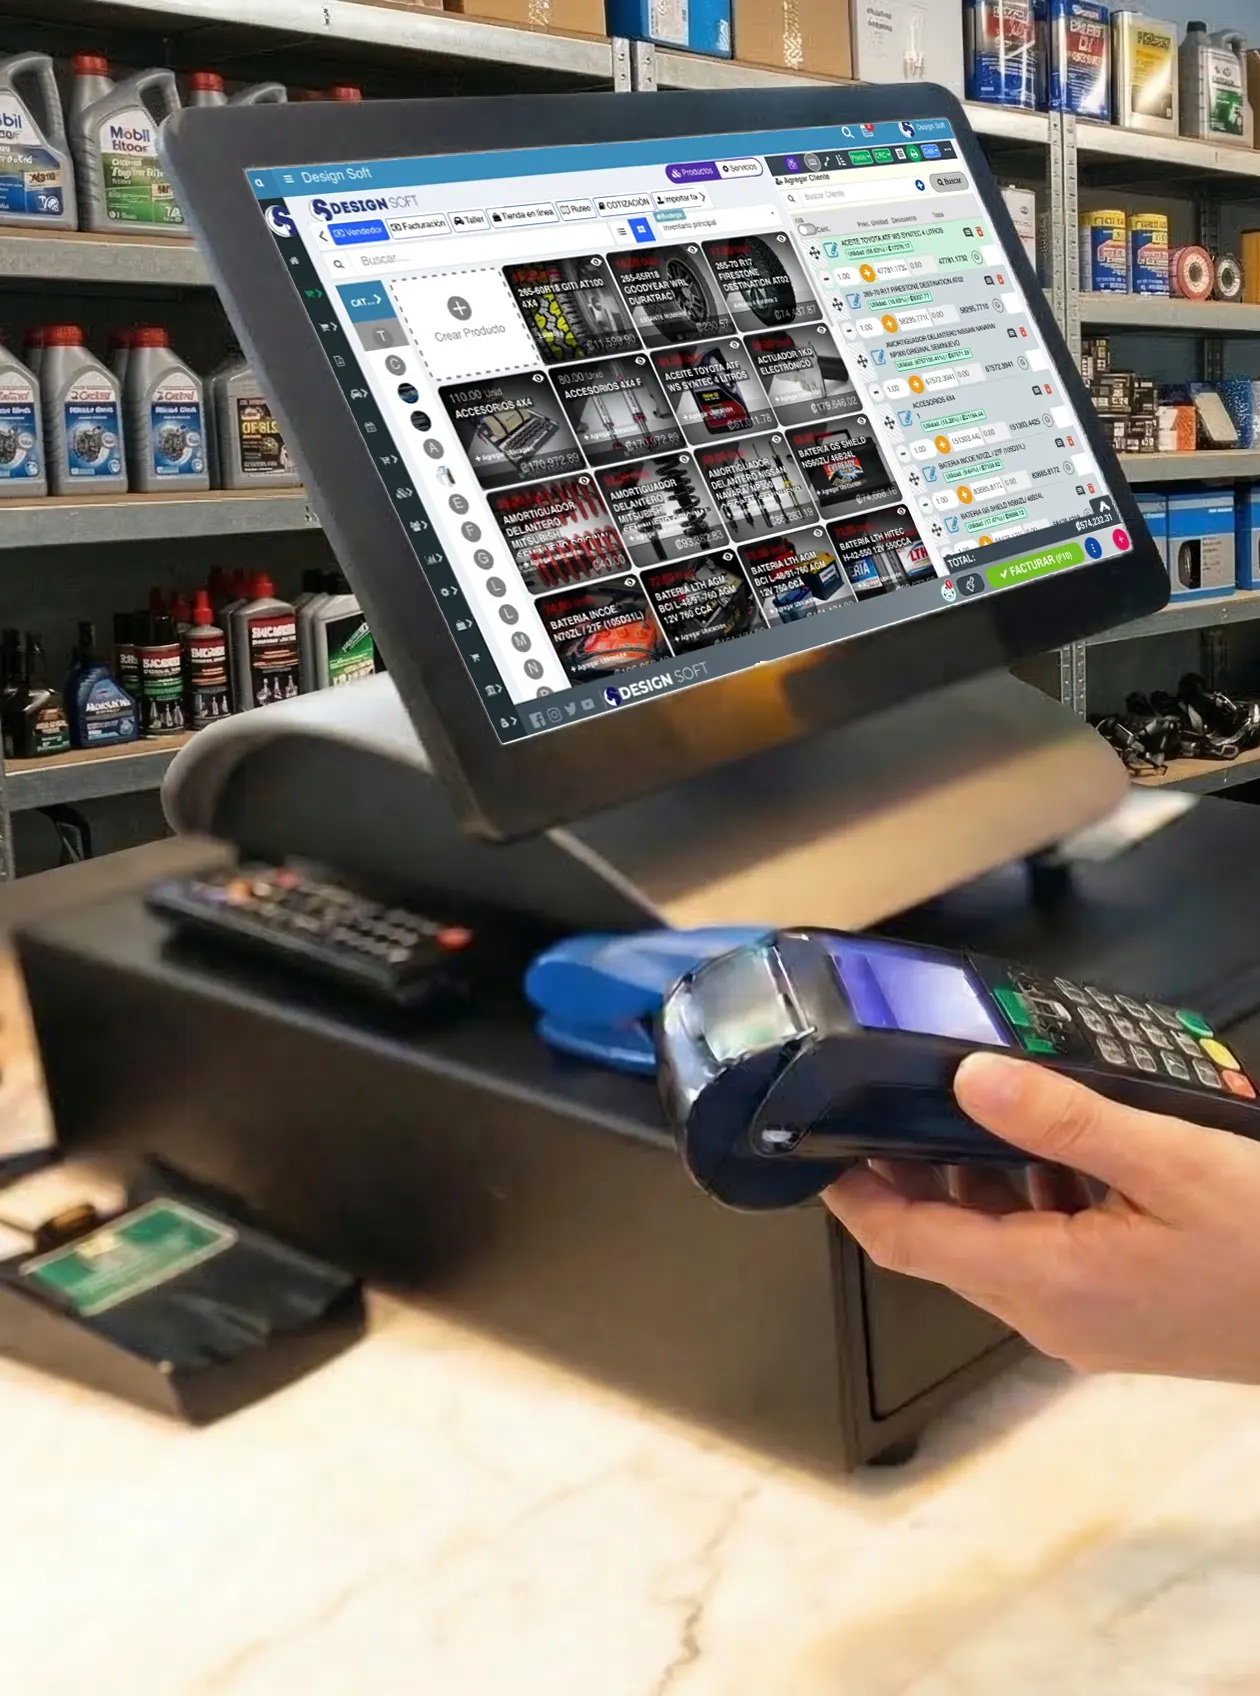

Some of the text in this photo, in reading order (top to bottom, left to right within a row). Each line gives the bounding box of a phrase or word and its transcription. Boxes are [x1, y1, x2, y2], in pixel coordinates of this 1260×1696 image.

[301, 167, 373, 184] Design Soft
[783, 173, 830, 186] Agregar Cliente
[330, 195, 419, 214] DESIGN SOFT
[606, 198, 650, 210] COTIZACIÓN
[463, 214, 485, 224] Taller
[718, 268, 760, 281] FIRESTONE
[624, 280, 670, 294] GOODYEAR
[723, 278, 771, 292] DESTINATION
[434, 324, 506, 342] Crear Producto
[757, 348, 813, 364] ACTUADOR 1KD
[665, 361, 740, 381] ACEITE TOYOTA ATF
[667, 382, 682, 392] WS
[683, 377, 713, 390] SYNTEC
[720, 370, 748, 382] LITROS
[564, 381, 620, 399] ACCESORIOS
[620, 378, 637, 388] 4X4
[455, 397, 533, 419] ACCESORIOS 4X4
[798, 445, 828, 458] BATERIA
[841, 436, 867, 448] SHIELD
[708, 457, 770, 479] AMORTIGUADOR
[609, 479, 677, 500] AMORTIGUADOR
[711, 473, 758, 490] DELANTERO
[502, 501, 576, 525] AMORTIGUADOR
[612, 494, 664, 512] DELANTERO
[505, 517, 561, 537] DELANTERO
[839, 537, 870, 551] BATERIA
[884, 528, 904, 540] HITEC
[751, 551, 817, 575] BATERIA LTH AGM
[948, 554, 977, 568] TOTAL:
[1009, 555, 1055, 577] FACTURAR
[754, 577, 769, 587] BCI
[809, 560, 826, 572] AGM
[788, 577, 805, 590] CCA
[654, 586, 691, 602] BATERIA
[691, 581, 707, 592] LTH
[707, 575, 726, 588] AGM
[658, 603, 675, 614] BCI
[718, 586, 737, 597] AGM
[550, 604, 618, 631] BATERIA INCOE
[664, 613, 679, 625] 12V
[694, 604, 713, 617] CCA
[620, 661, 709, 700] DESIGN SOFT
